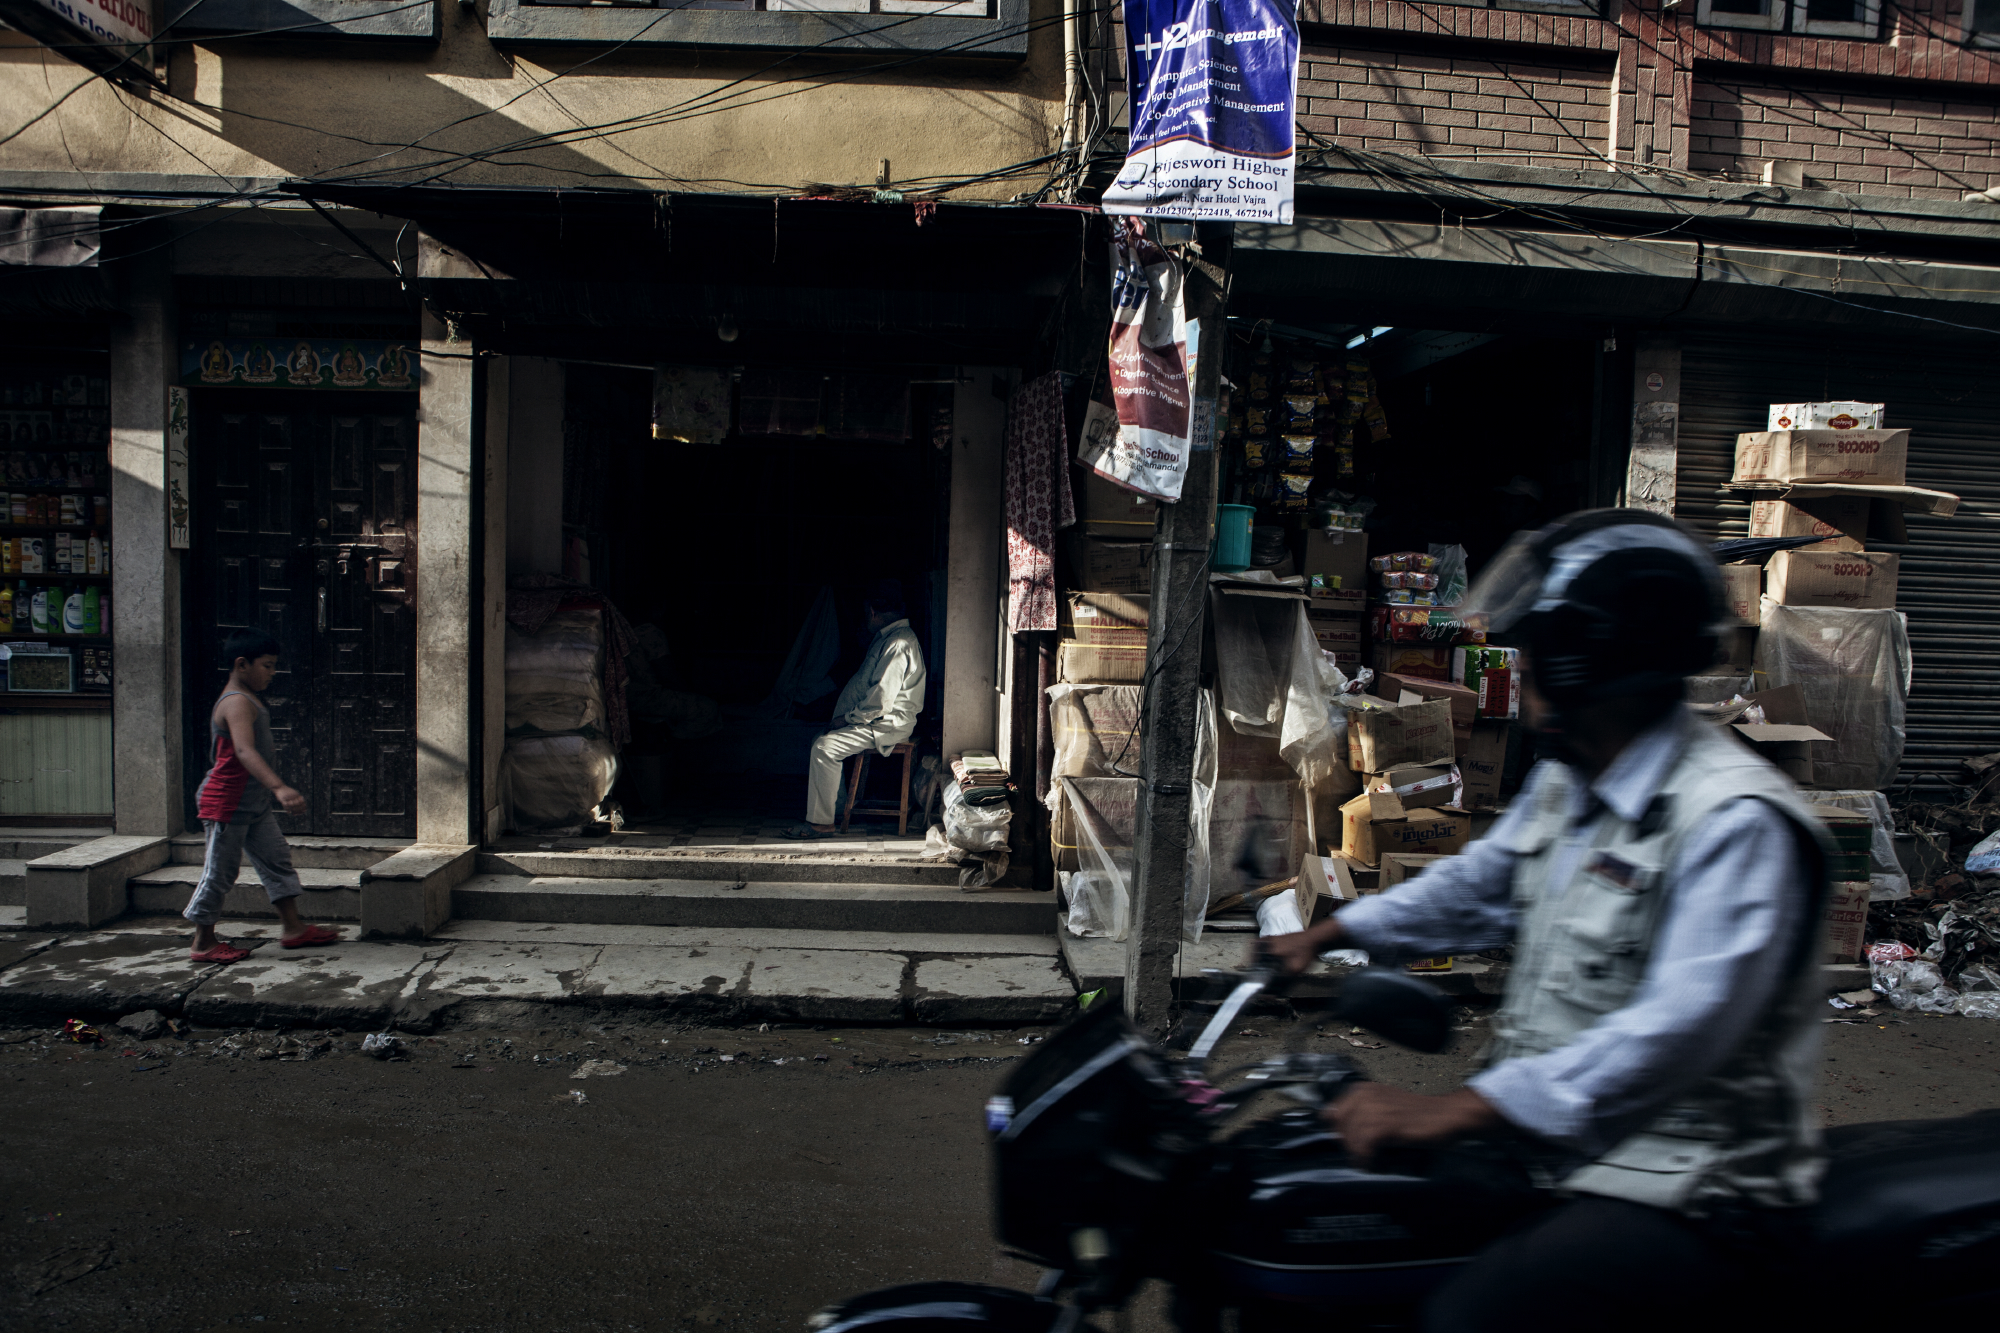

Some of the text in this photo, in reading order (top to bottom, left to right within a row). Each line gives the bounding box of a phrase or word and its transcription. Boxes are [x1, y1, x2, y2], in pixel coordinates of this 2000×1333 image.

[78, 11, 125, 43] Floor
[1188, 24, 1284, 46] Management
[1198, 57, 1238, 74] Science
[1151, 79, 1241, 102] Hotel Management
[1147, 94, 1285, 121] Co-Operative Management
[1158, 127, 1170, 137] feel
[1171, 124, 1183, 132] free
[1152, 156, 1289, 177] Bijeswori Higher
[1147, 175, 1279, 191] Secondary School
[1192, 194, 1213, 203] Near
[1216, 194, 1240, 203] Hotel
[1243, 195, 1267, 205] Vajra
[1155, 207, 1273, 218] 2012307, 272418, 4672194
[1151, 374, 1180, 395] Science
[1159, 391, 1187, 409] Mgmt.
[1145, 447, 1180, 463] School
[1838, 441, 1880, 453] CHOCOS
[1837, 469, 1866, 480] Kellogg's
[1834, 563, 1873, 576] CHOCOS
[1489, 672, 1499, 714] Cracker
[1498, 675, 1507, 710] Butter
[1825, 911, 1863, 922] Parle-G
